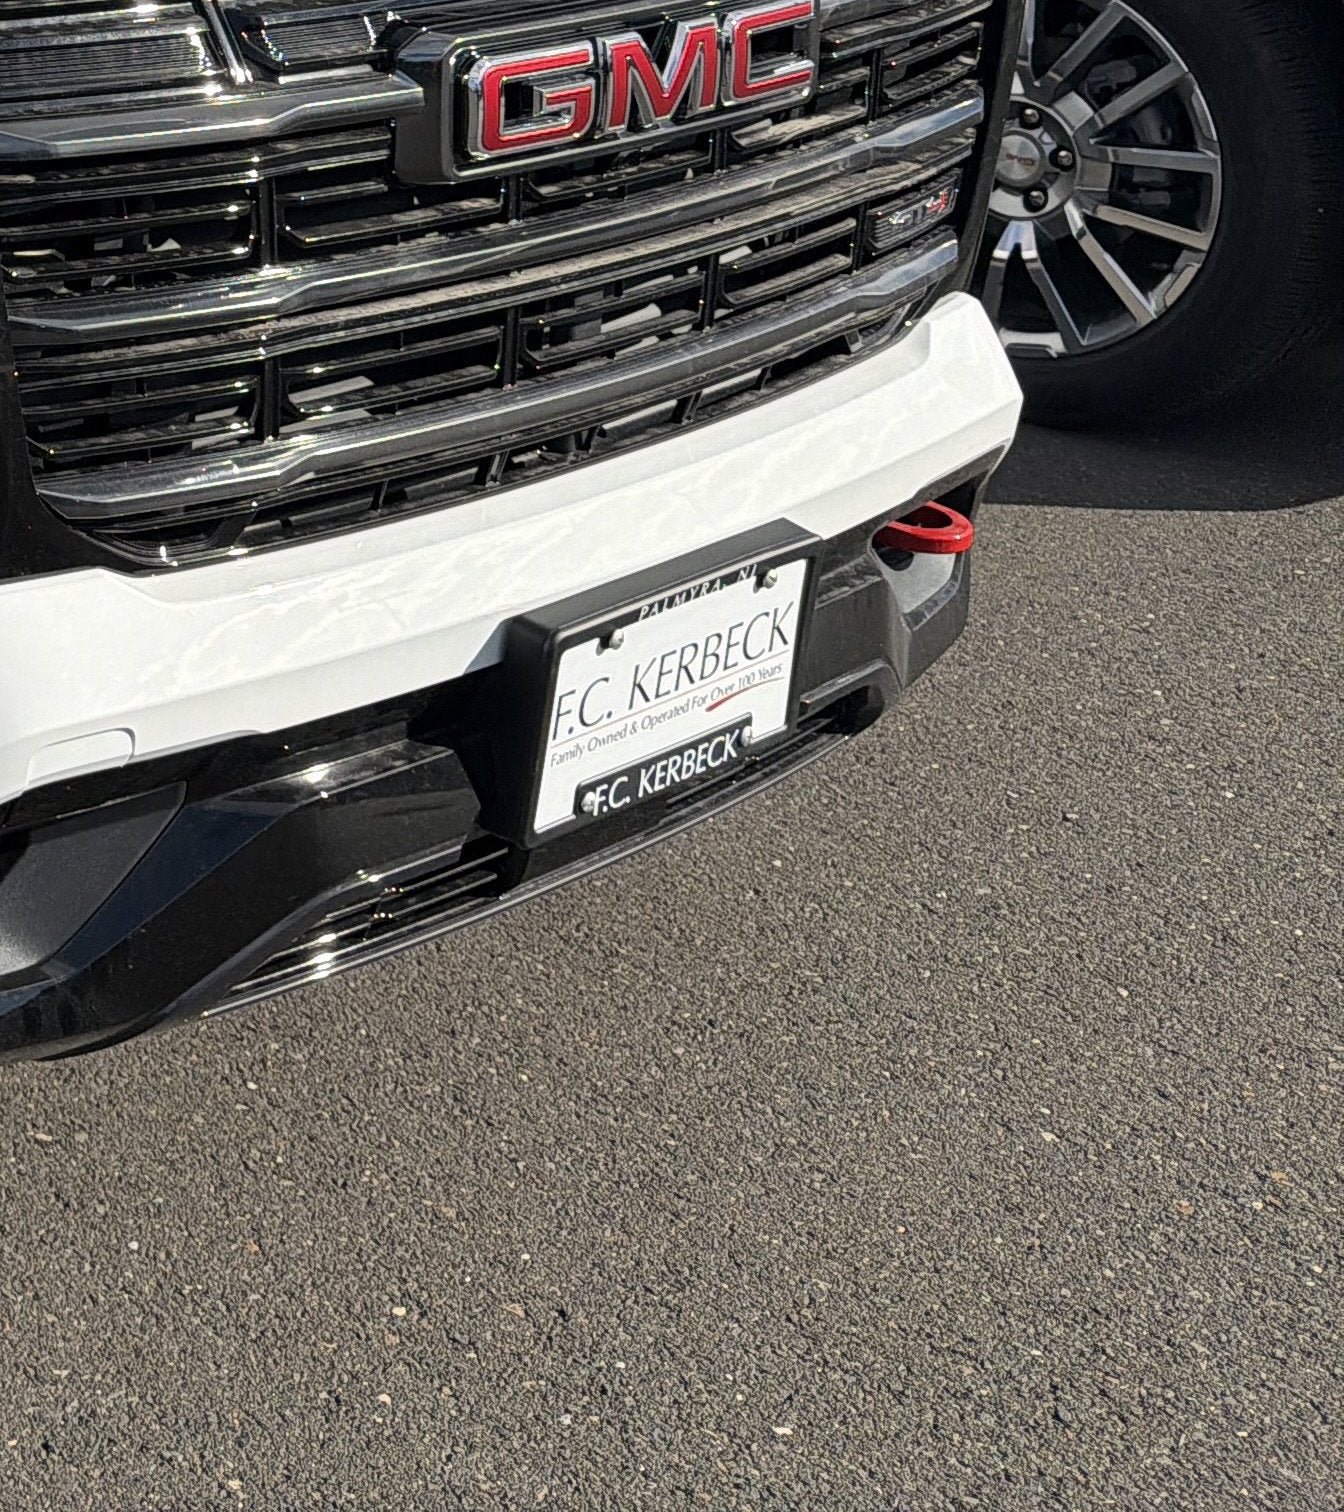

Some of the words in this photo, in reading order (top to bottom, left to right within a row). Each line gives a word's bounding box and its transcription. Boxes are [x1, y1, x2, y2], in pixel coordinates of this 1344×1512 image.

[550, 743, 586, 768] Family
[587, 723, 629, 752] Owned
[629, 720, 639, 736] &
[640, 696, 691, 732] Operated
[691, 692, 709, 714] For
[710, 682, 736, 701] Over
[737, 671, 756, 689] 100
[757, 662, 784, 681] Years
[552, 676, 614, 741] F.C.
[627, 600, 795, 711] KERBECK
[590, 775, 631, 818] F.C.
[637, 728, 743, 799] KERBECK
